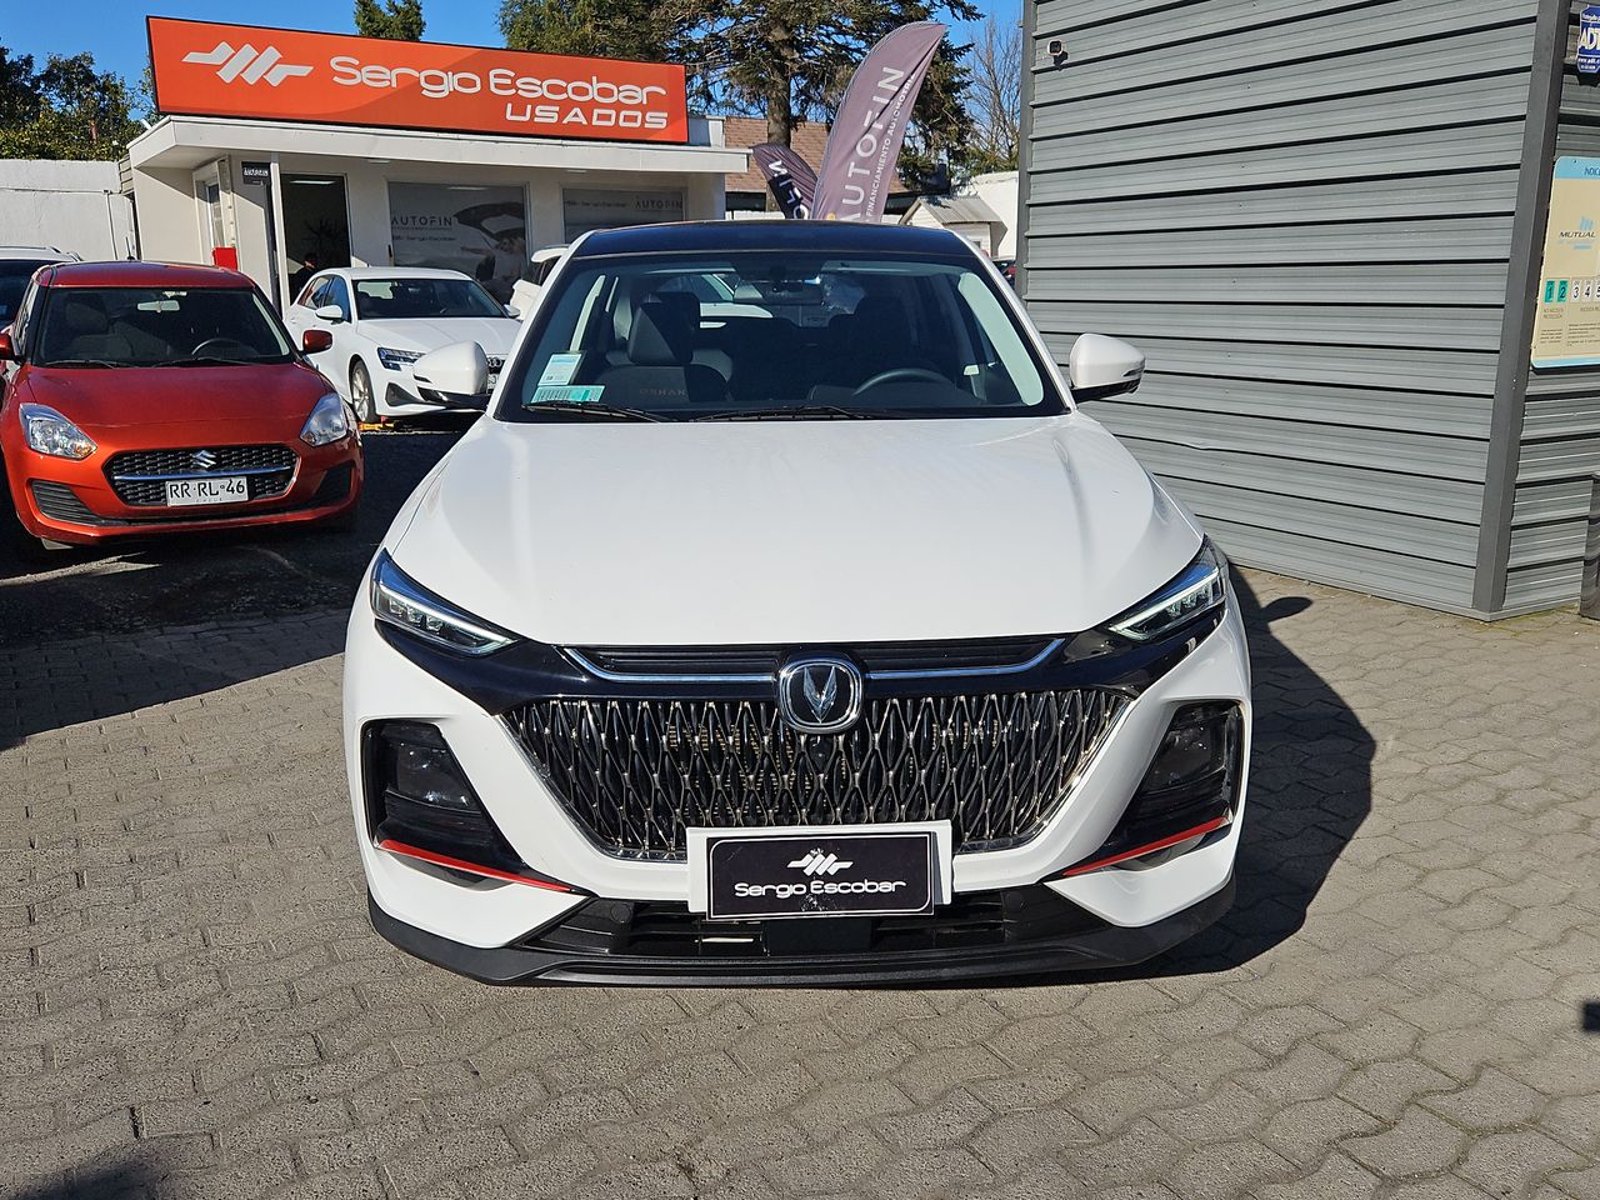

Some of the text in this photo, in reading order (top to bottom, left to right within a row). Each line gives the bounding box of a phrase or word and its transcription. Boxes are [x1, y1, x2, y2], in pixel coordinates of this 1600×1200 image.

[329, 56, 667, 105] Sergio Escobar
[505, 103, 668, 129] USADOS
[866, 138, 891, 217] FINANCIAMIENTO
[391, 215, 453, 226] AUTOFIN
[1573, 286, 1580, 299] 3
[1584, 286, 1591, 297] 4
[734, 879, 907, 899] Sergio Escobar
